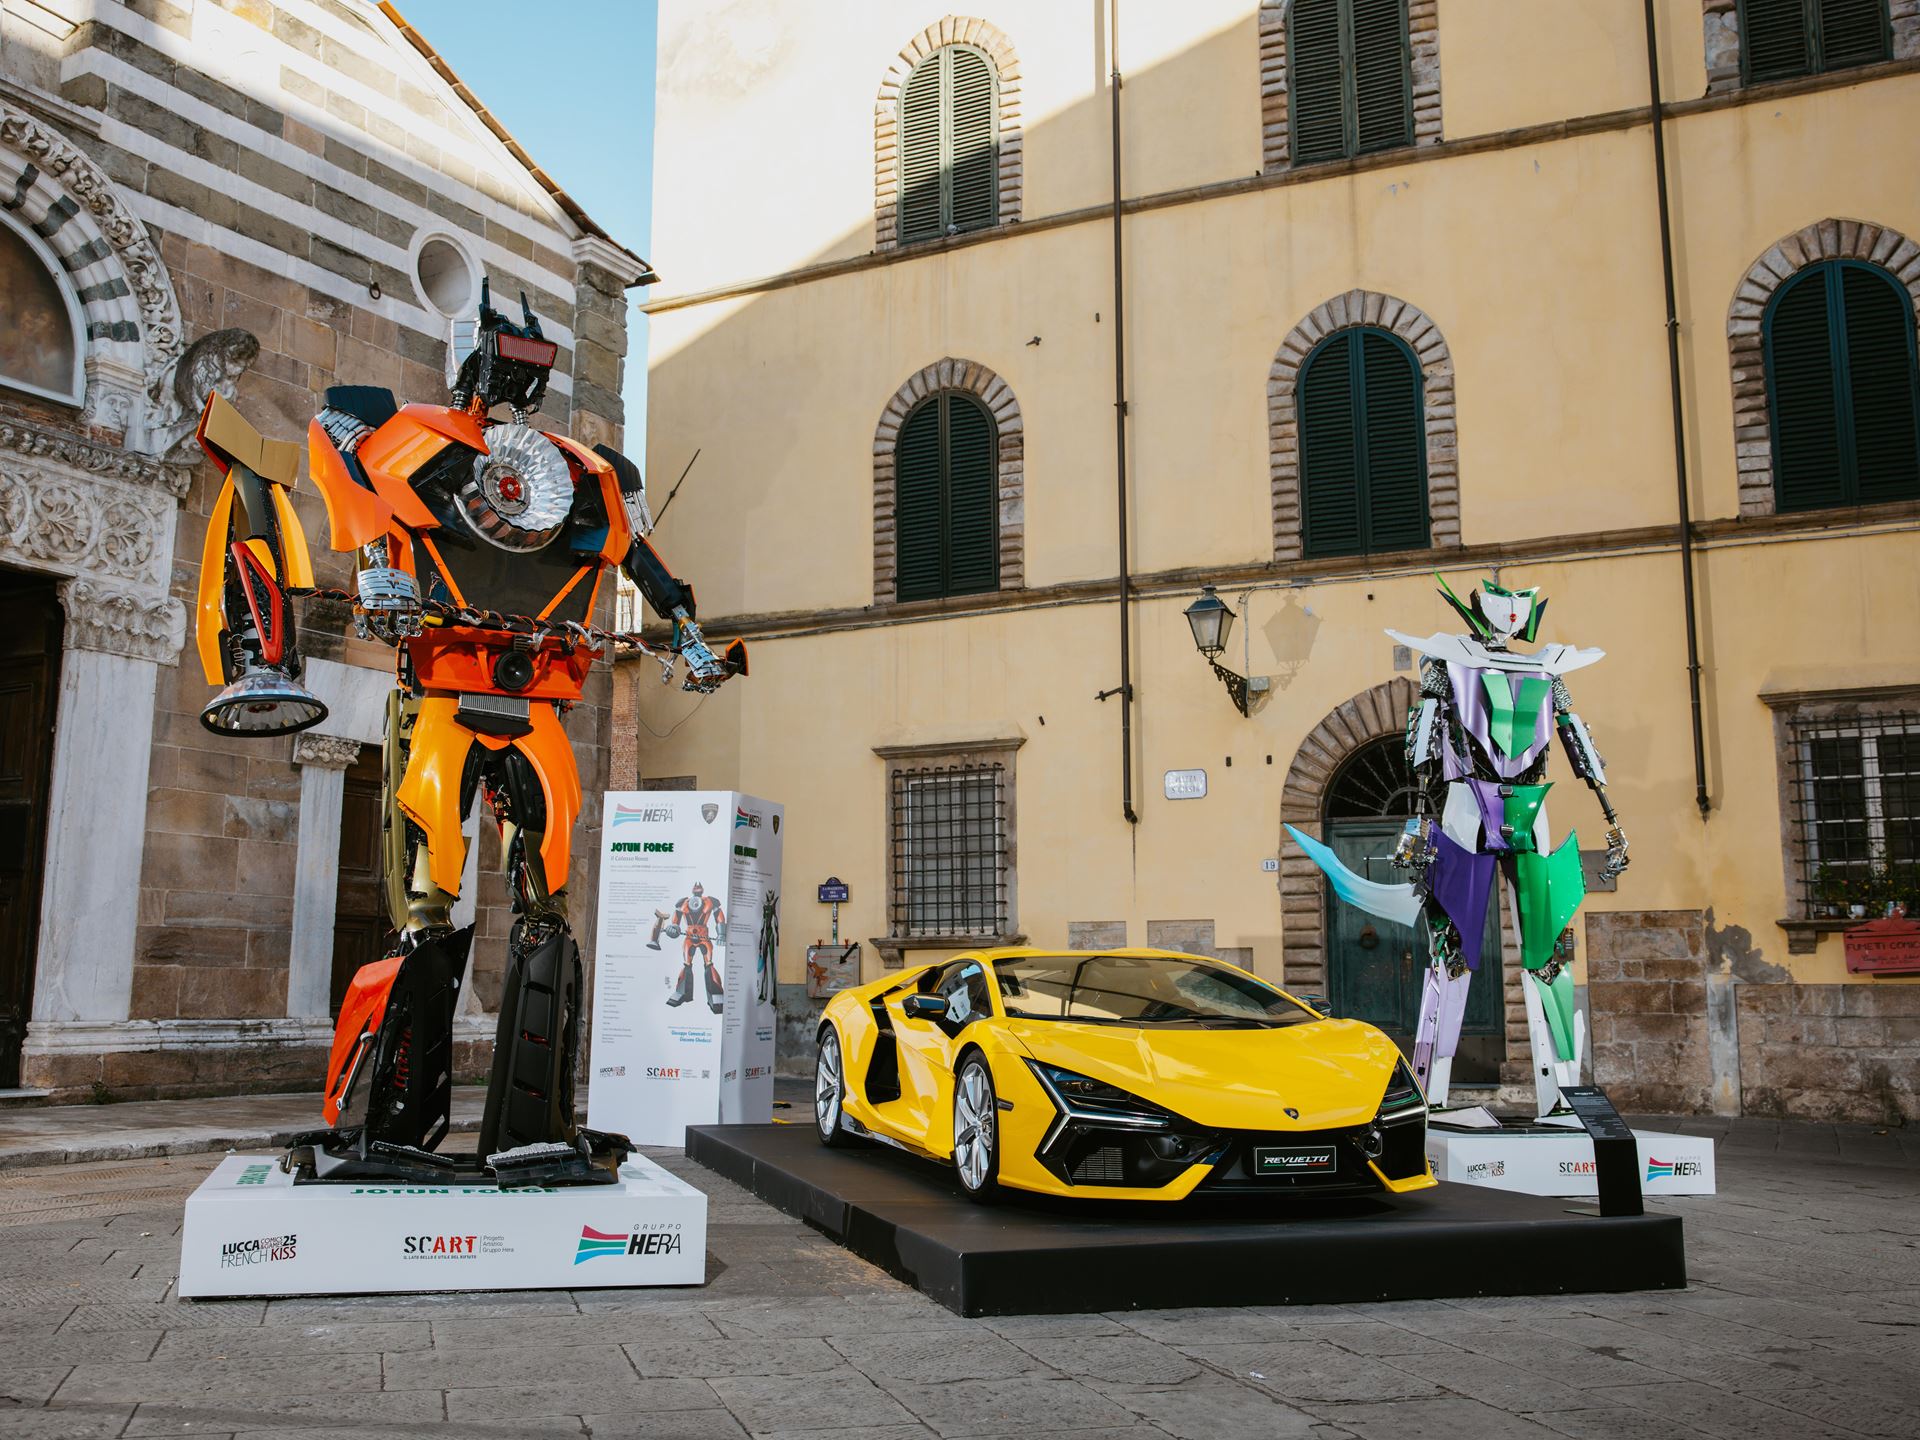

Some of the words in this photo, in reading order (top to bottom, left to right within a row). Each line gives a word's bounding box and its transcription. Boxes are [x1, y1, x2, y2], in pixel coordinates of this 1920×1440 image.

[642, 809, 673, 822] HERA
[610, 842, 641, 852] JOTUN
[643, 842, 675, 852] FORGE
[1265, 861, 1276, 870] 19
[646, 1067, 680, 1078] SCART
[1264, 1154, 1330, 1164] REVUELTO
[1467, 1163, 1487, 1173] LUCCA
[1497, 1160, 1505, 1169] 25
[1491, 1167, 1505, 1177] KISS
[1559, 1162, 1596, 1173] SCART
[1674, 1162, 1702, 1176] HERA
[462, 1187, 560, 1195] FORGE
[633, 1223, 682, 1231] GRUPPO
[222, 1240, 260, 1255] LUCCA
[260, 1236, 283, 1245] COMICS
[282, 1234, 297, 1247] 25
[403, 1236, 478, 1253] SCART
[627, 1233, 681, 1255] HERA
[221, 1249, 268, 1268] FRENCH
[270, 1245, 297, 1261] KISS
